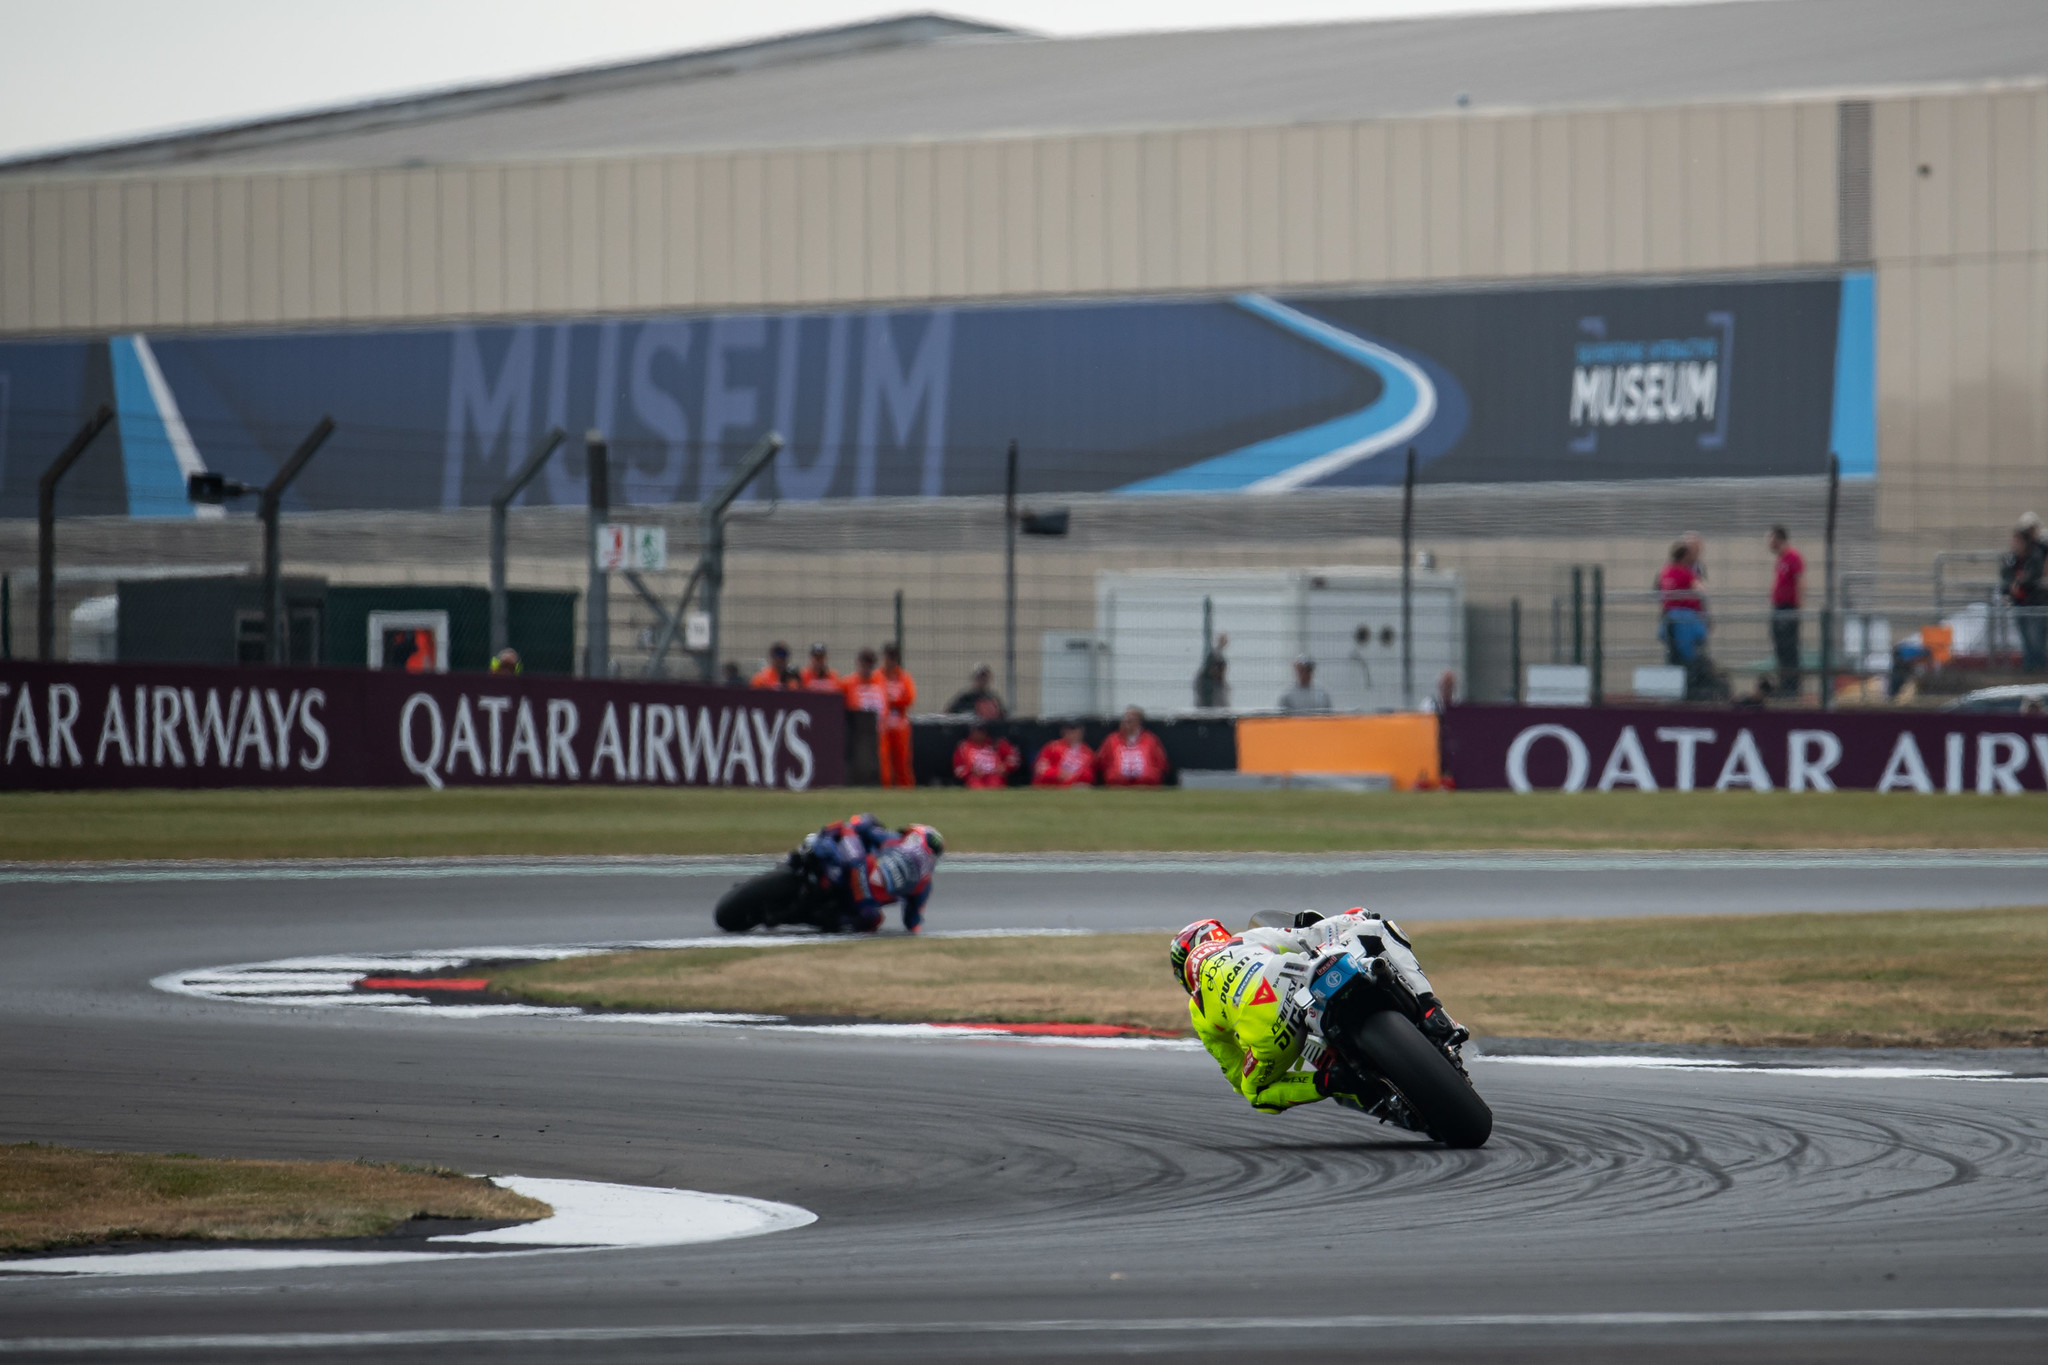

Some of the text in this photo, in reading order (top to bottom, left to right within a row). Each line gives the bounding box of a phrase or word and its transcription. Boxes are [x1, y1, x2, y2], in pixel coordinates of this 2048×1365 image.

[442, 311, 955, 508] MUSEUM
[1569, 360, 1718, 427] MUSEUM
[95, 684, 329, 771] AIRWAYS
[400, 692, 814, 792] QATAR AIRWAYS
[1876, 730, 2048, 795] AIR
[1205, 950, 1233, 991] ebay
[1220, 956, 1250, 1005] DUCATI
